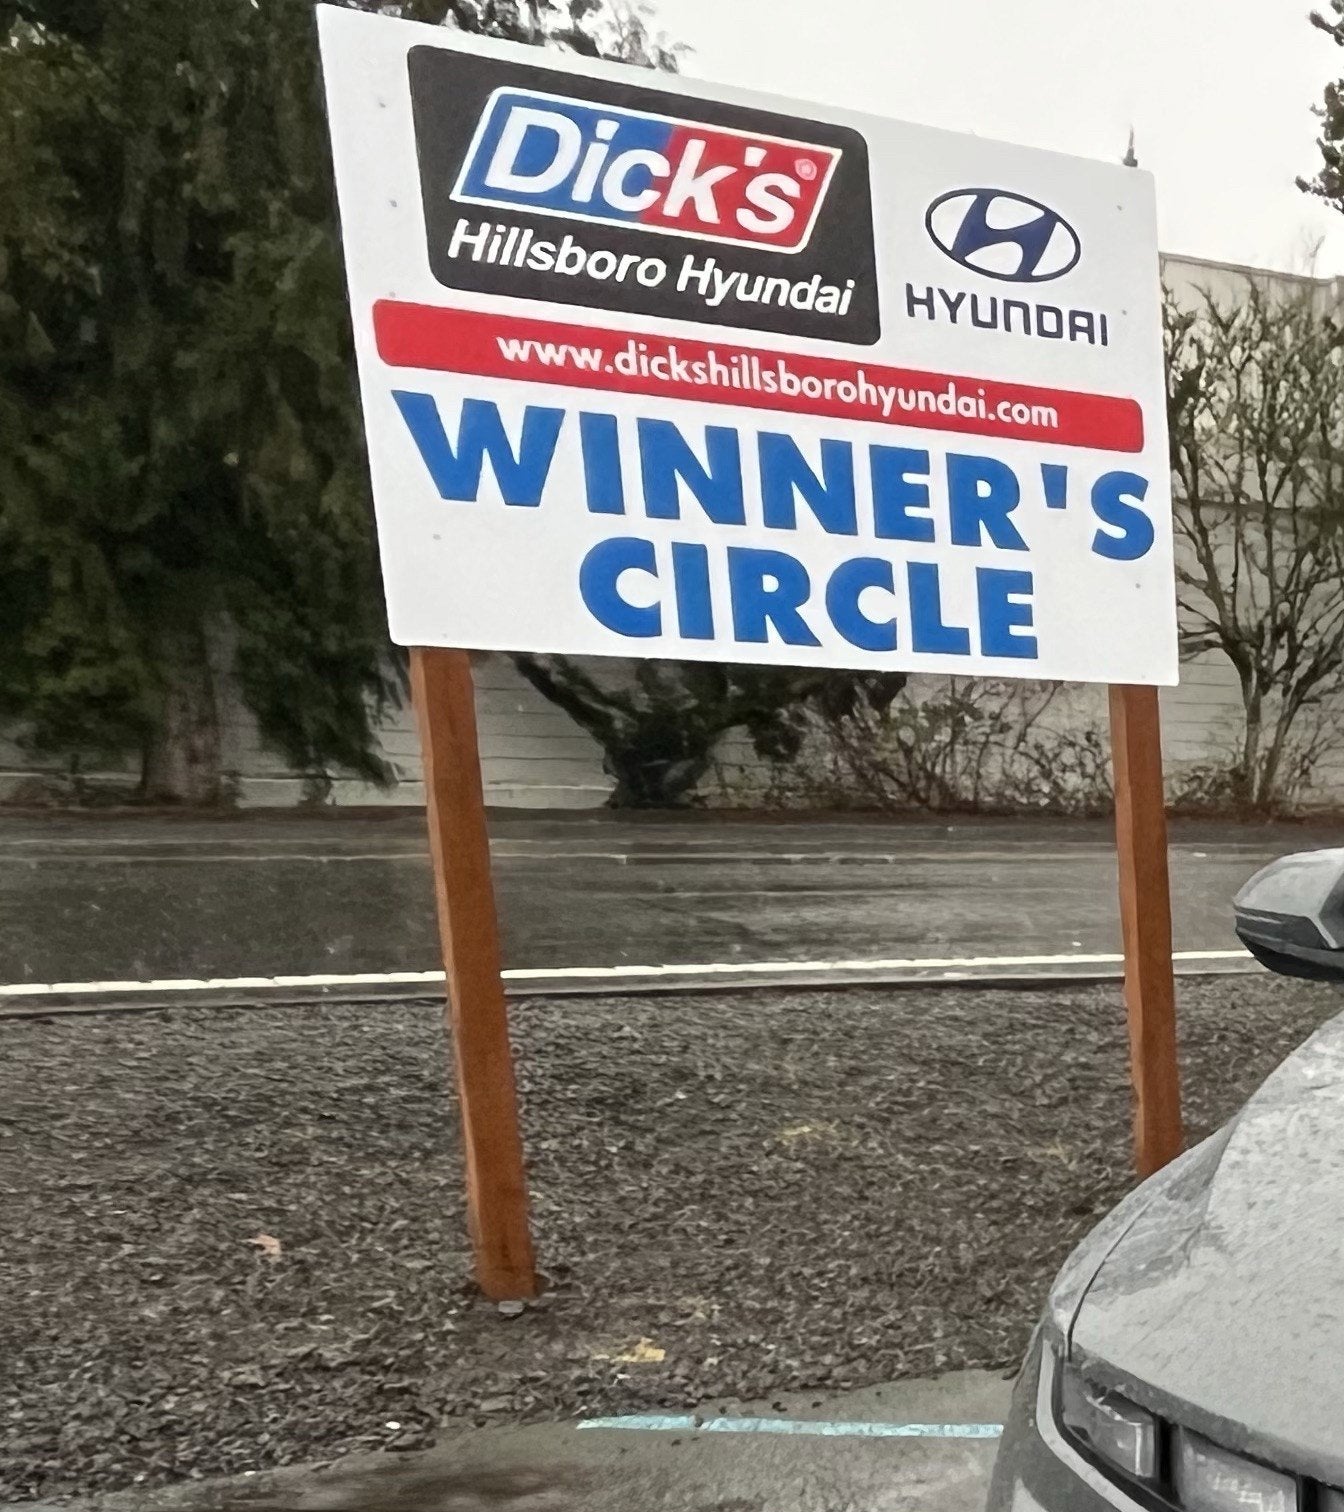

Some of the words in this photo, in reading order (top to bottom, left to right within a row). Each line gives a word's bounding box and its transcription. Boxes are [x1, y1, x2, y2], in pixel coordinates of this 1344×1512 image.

[483, 105, 804, 235] Dick's
[447, 219, 668, 291] Hillsboro
[676, 255, 856, 316] Hyundai
[905, 283, 1109, 347] HYUNDAI
[496, 333, 1059, 428] www.dickshillsborohyundai.com
[392, 390, 1154, 561] WINNER'S
[578, 537, 1038, 660] CIRCLE
